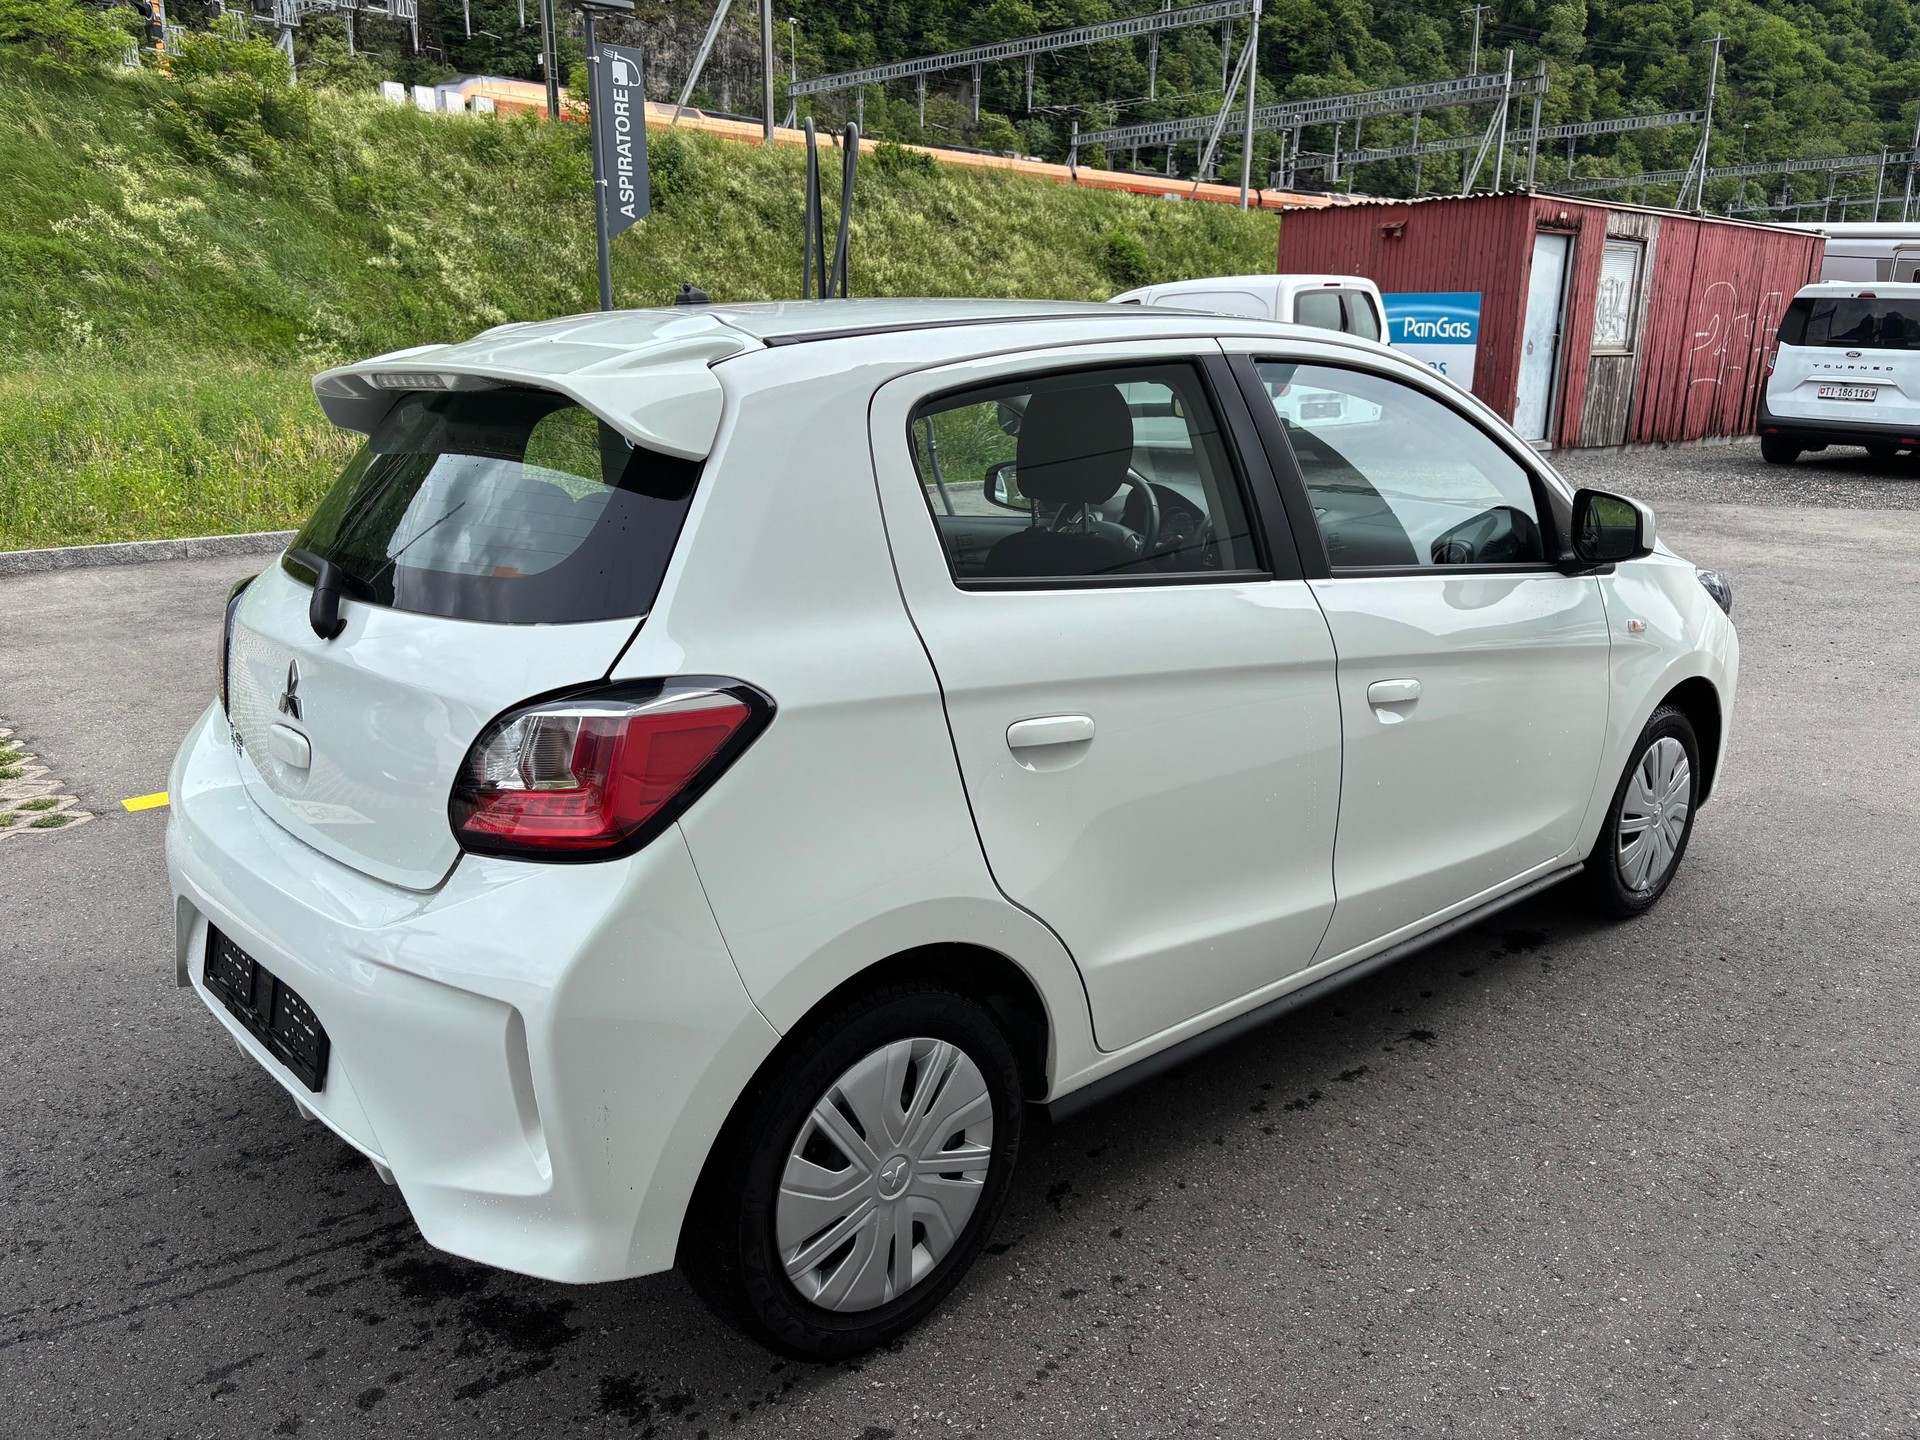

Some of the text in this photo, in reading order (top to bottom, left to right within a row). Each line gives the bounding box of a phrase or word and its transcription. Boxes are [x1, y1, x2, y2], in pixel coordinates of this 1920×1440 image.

[613, 87, 635, 219] ASPIRATORE
[1403, 316, 1472, 338] PanGas
[1813, 363, 1894, 371] TOURNEO
